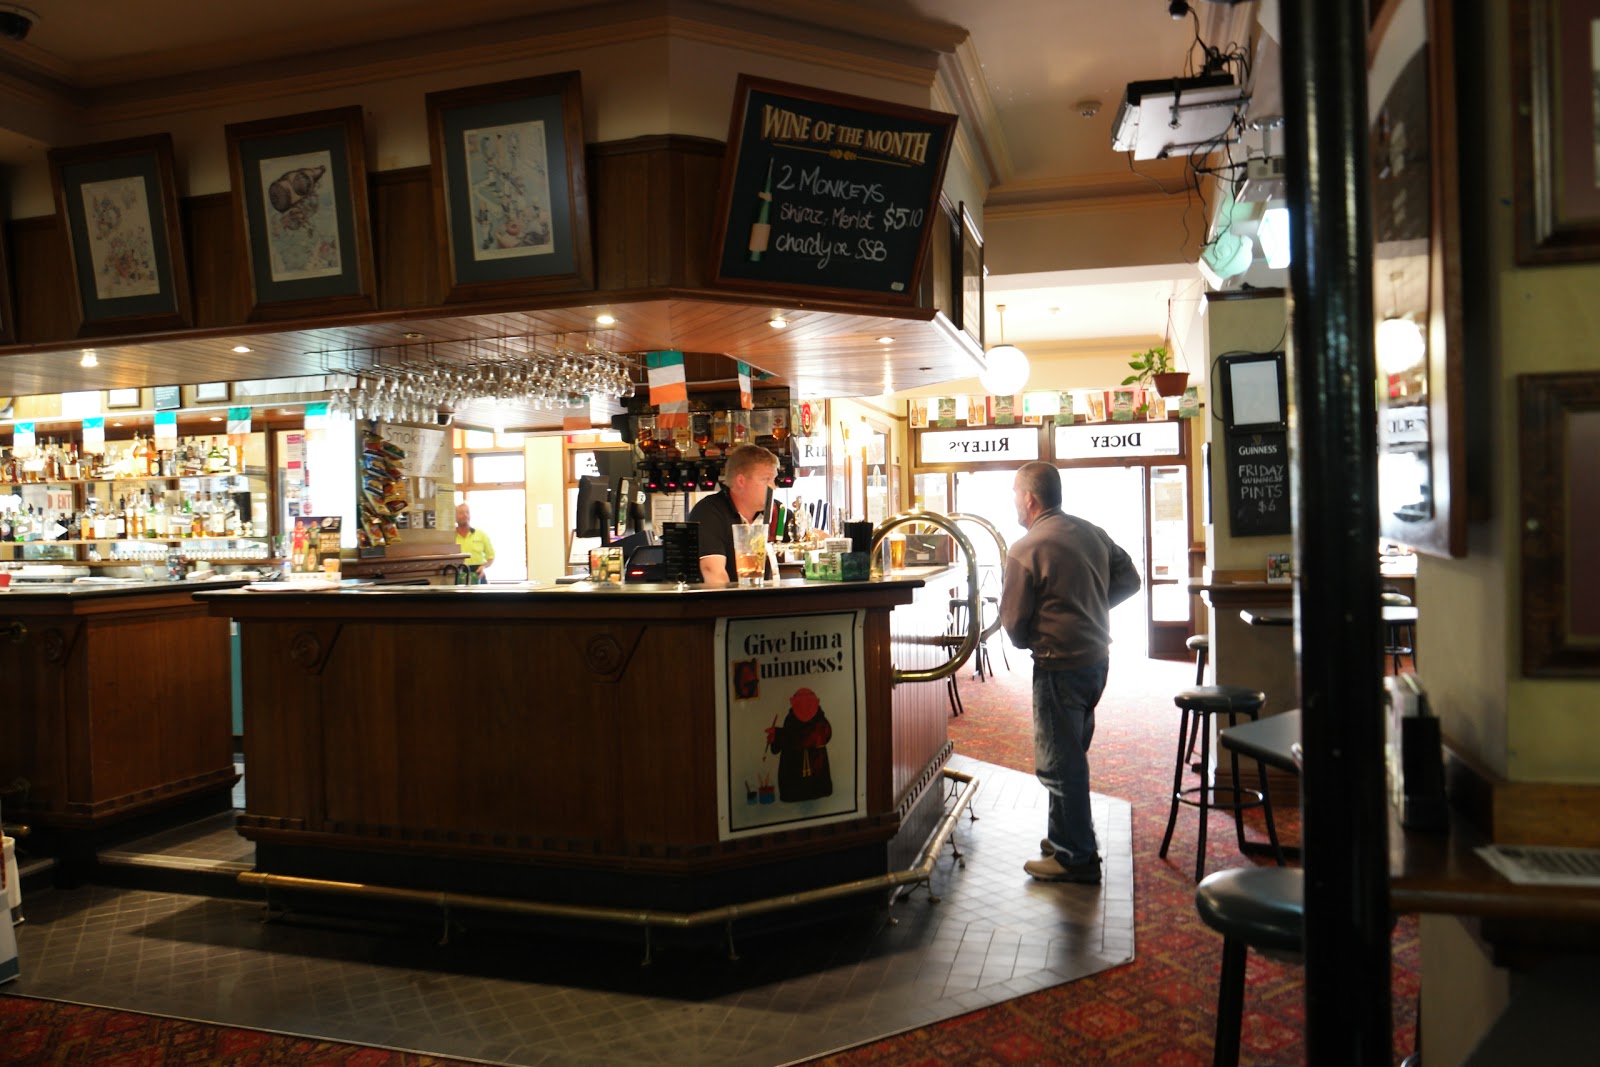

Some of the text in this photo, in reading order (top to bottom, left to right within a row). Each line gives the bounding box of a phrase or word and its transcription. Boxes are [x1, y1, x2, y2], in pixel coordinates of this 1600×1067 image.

[761, 104, 931, 163] WINE OF THE MONTH
[776, 164, 795, 190] 2
[854, 238, 887, 261] SSB
[1238, 445, 1278, 456] GUINNESS
[1238, 463, 1284, 478] FRIDAY
[1242, 475, 1283, 484] GUINNESS
[1241, 484, 1283, 499] PINTS
[744, 631, 842, 656] Give him a
[734, 652, 843, 699] Guinness!
